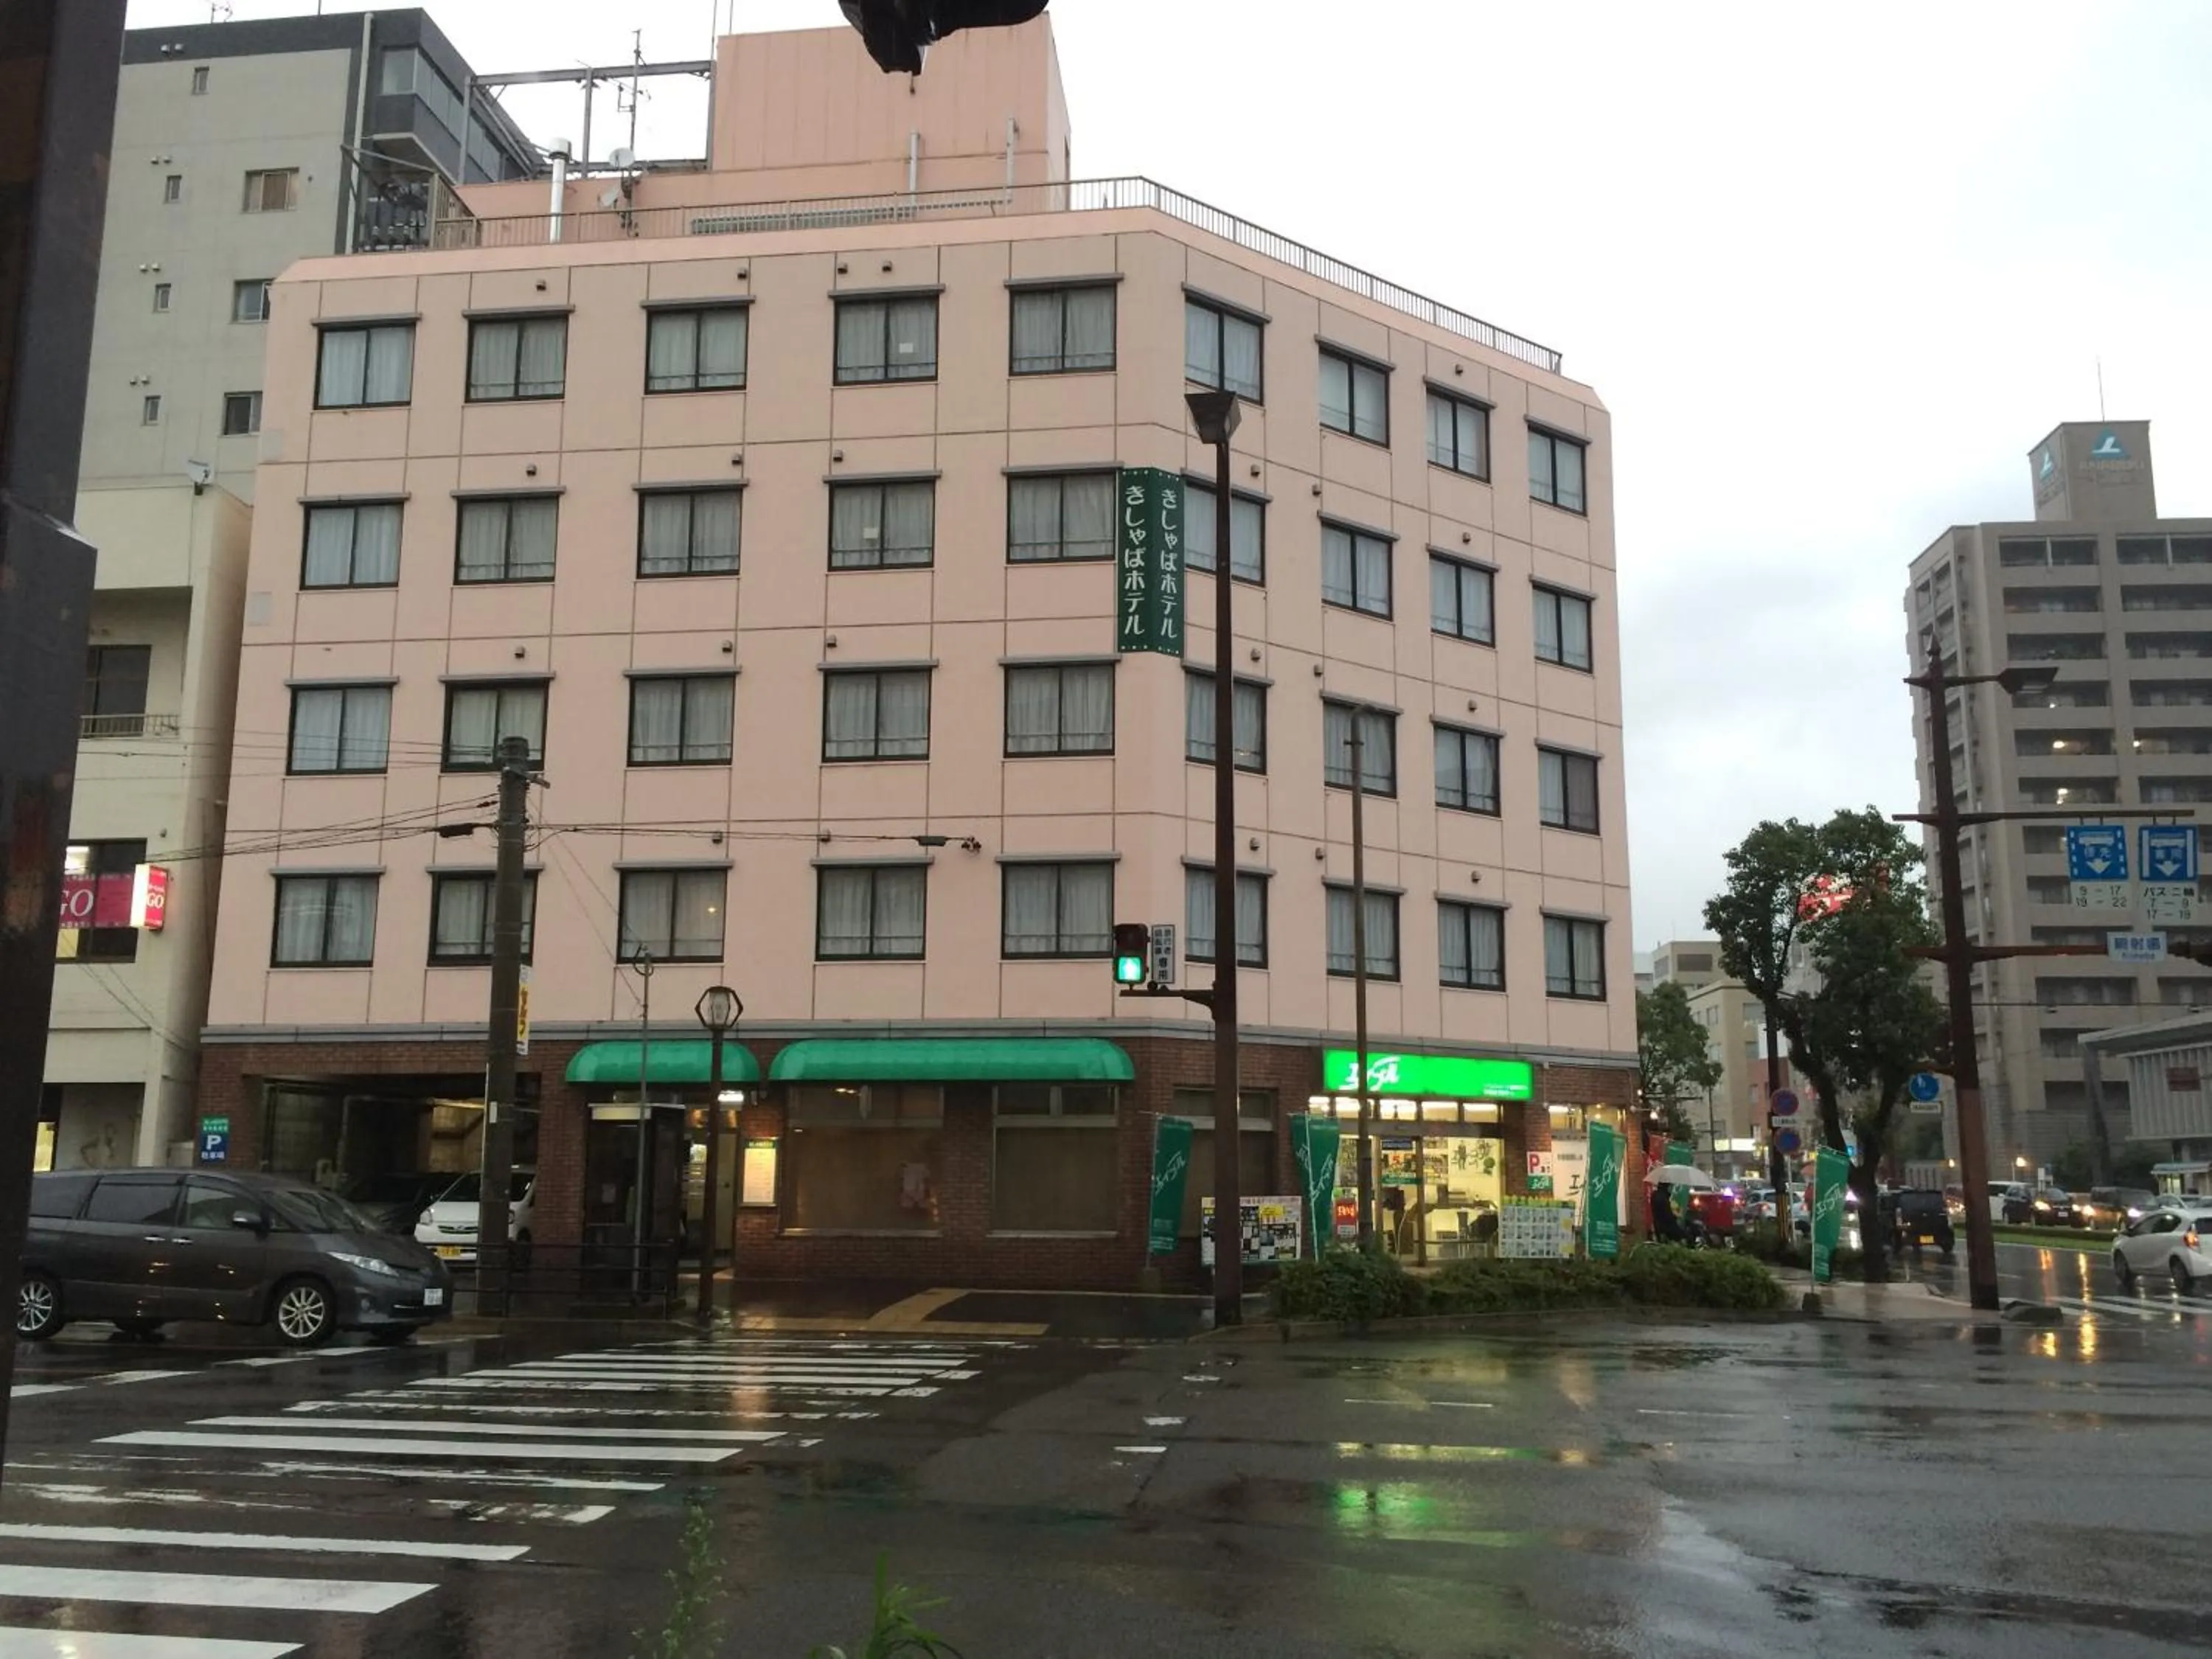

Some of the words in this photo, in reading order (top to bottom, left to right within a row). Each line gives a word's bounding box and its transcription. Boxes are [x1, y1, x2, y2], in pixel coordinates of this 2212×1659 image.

[1124, 485, 1147, 635] きしゃばホテル
[1161, 489, 1178, 638] きしゃばホテル
[2110, 886, 2121, 895] 17
[2112, 897, 2128, 908] 22
[207, 1135, 222, 1150] P
[1529, 1155, 1540, 1173] P
